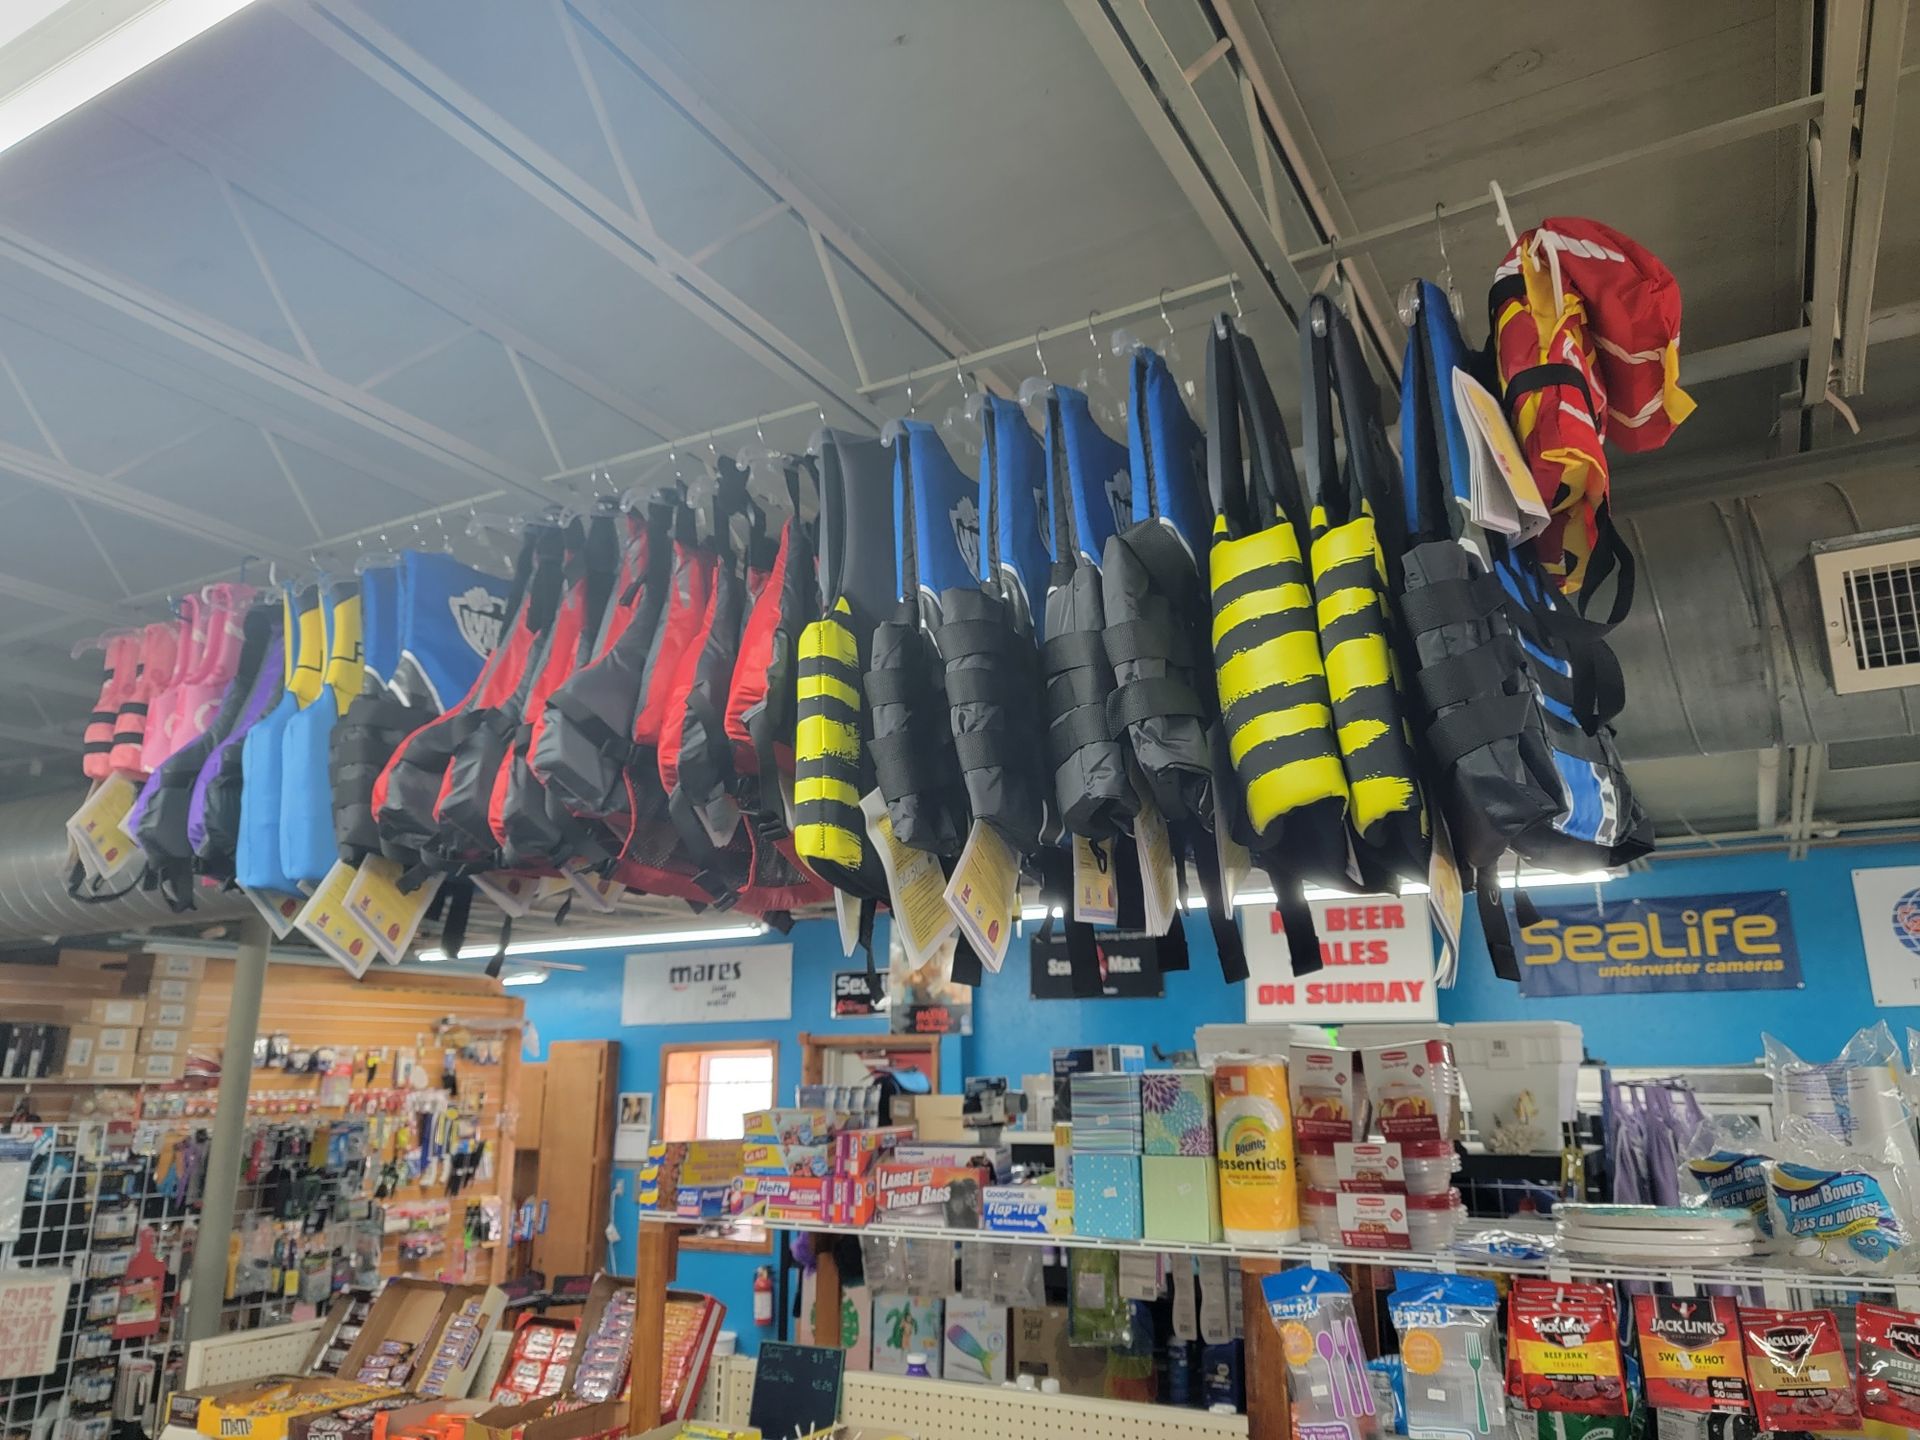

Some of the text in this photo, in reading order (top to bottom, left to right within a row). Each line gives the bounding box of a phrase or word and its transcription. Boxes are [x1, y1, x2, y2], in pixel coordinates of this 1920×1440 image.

[1325, 905, 1405, 932] BEER
[1521, 908, 1782, 966] SeaLife
[1318, 941, 1389, 966] ALES
[670, 961, 741, 983] mares
[1107, 954, 1142, 973] Max
[1599, 959, 1785, 978] underwater cameras
[1258, 981, 1424, 1005] ON SUNDAY
[1219, 1158, 1286, 1171] essentials
[760, 1183, 787, 1194] Hefty
[1650, 1317, 1685, 1334] JACK
[1704, 1355, 1725, 1364] HOT
